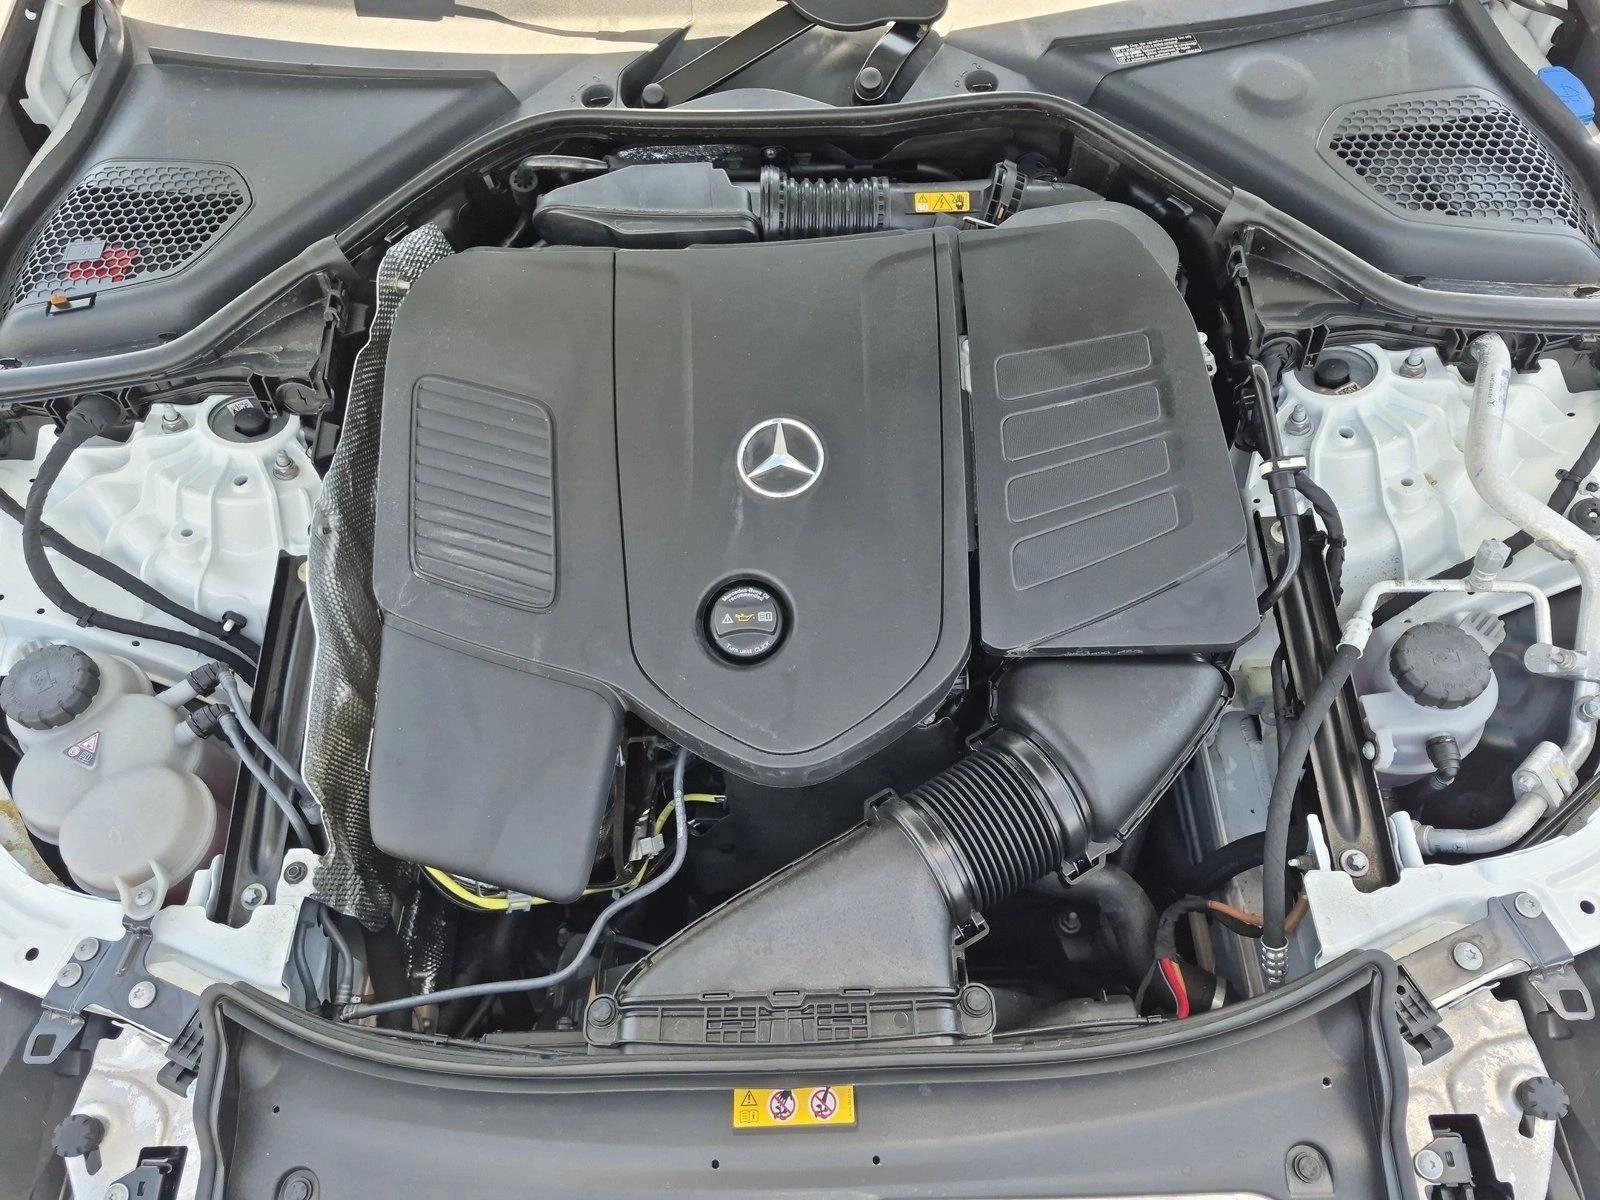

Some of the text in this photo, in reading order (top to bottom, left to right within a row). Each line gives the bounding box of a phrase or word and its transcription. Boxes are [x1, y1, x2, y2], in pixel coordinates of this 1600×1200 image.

[721, 587, 762, 602] Mercedes-Benz
[728, 592, 763, 602] recommended
[726, 642, 739, 653] Turn
[754, 641, 771, 653] CLICK
